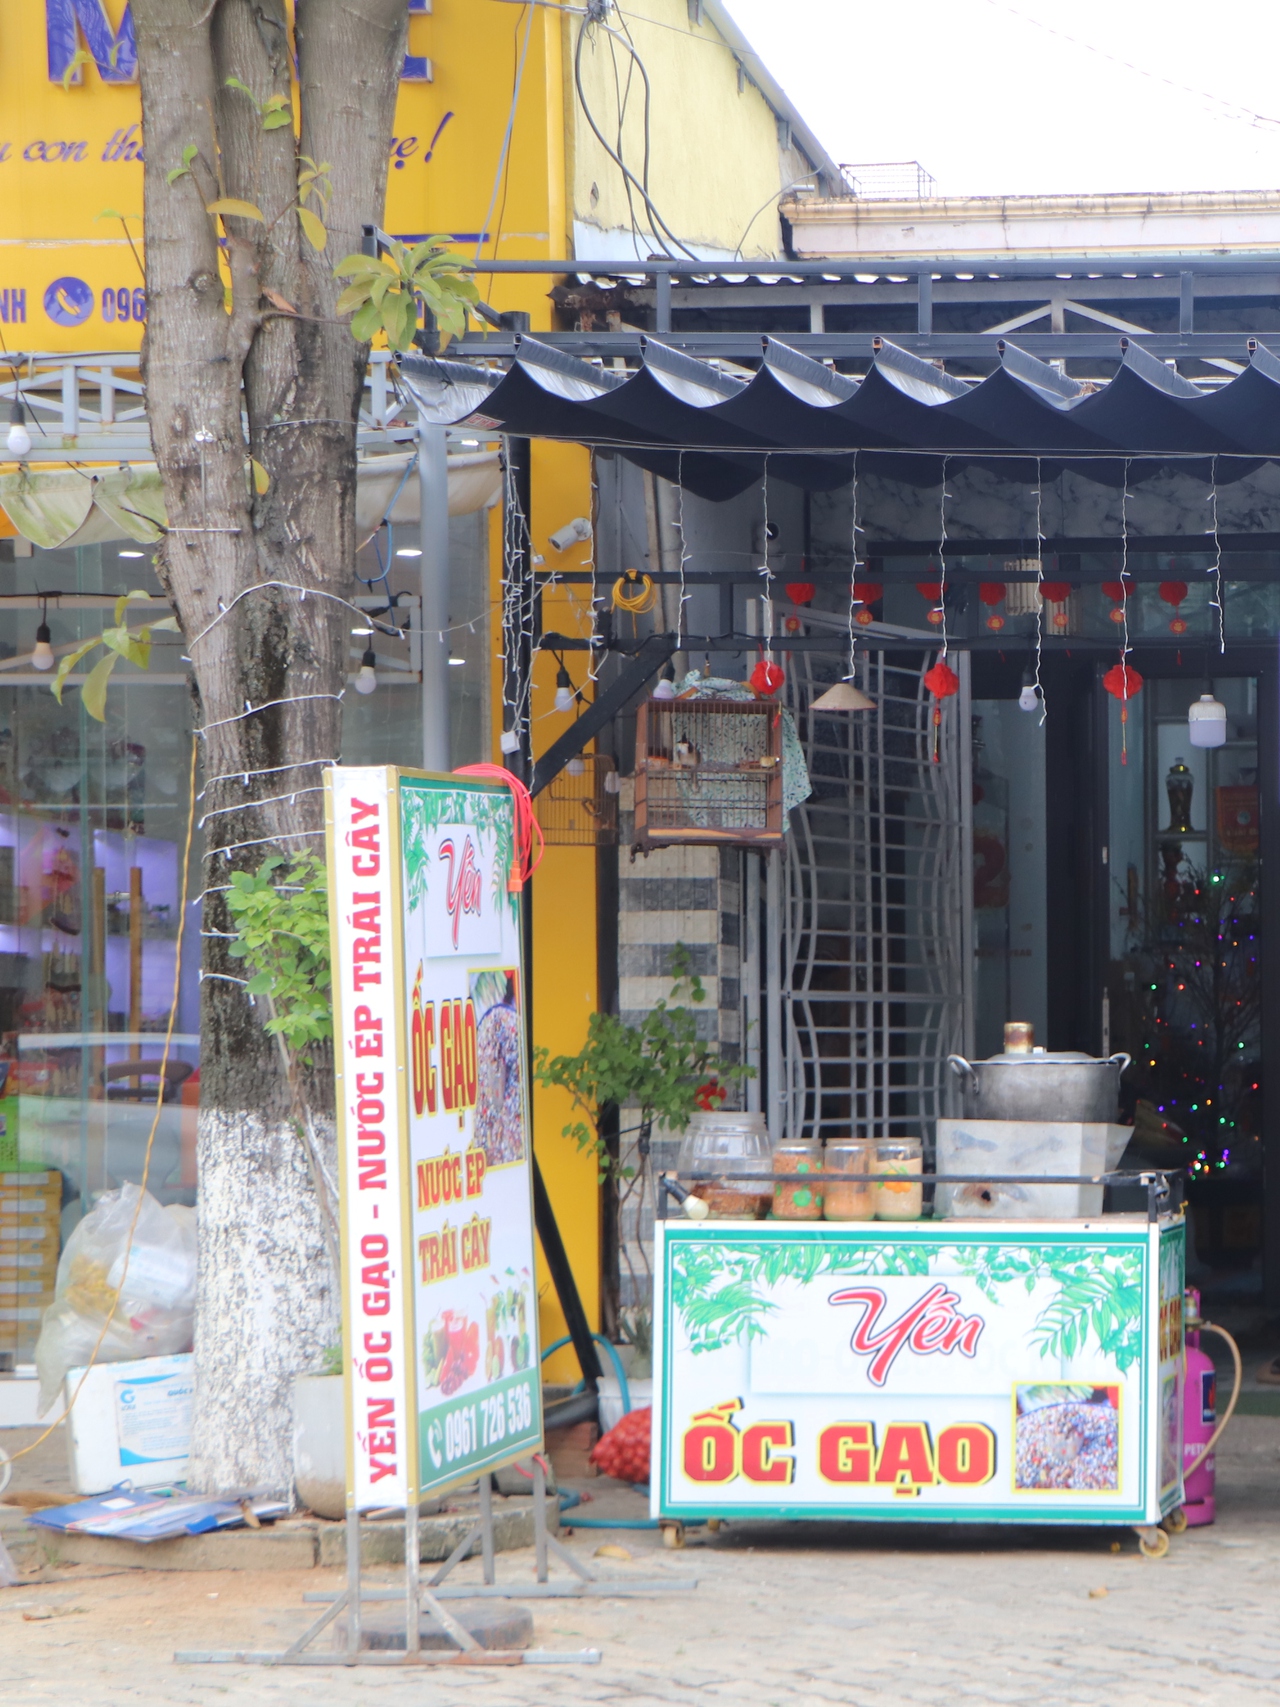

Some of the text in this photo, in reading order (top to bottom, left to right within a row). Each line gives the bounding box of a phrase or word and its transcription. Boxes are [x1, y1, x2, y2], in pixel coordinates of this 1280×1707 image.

[23, 140, 88, 162] con
[345, 797, 381, 877] CÂY
[439, 834, 481, 950] Yến
[347, 891, 383, 992] TRÁI
[349, 1005, 385, 1058] ÉP
[440, 996, 478, 1132] GẠO
[351, 1072, 388, 1190] NƯỚC
[416, 1139, 487, 1212] NƯỚC ÉP
[361, 1234, 395, 1317] GẠO
[418, 1212, 491, 1286] TRÁI CÂY
[828, 1283, 985, 1387] Yến
[445, 1381, 532, 1461] 0961 726 536
[682, 1397, 996, 1496] ỐC GẠO
